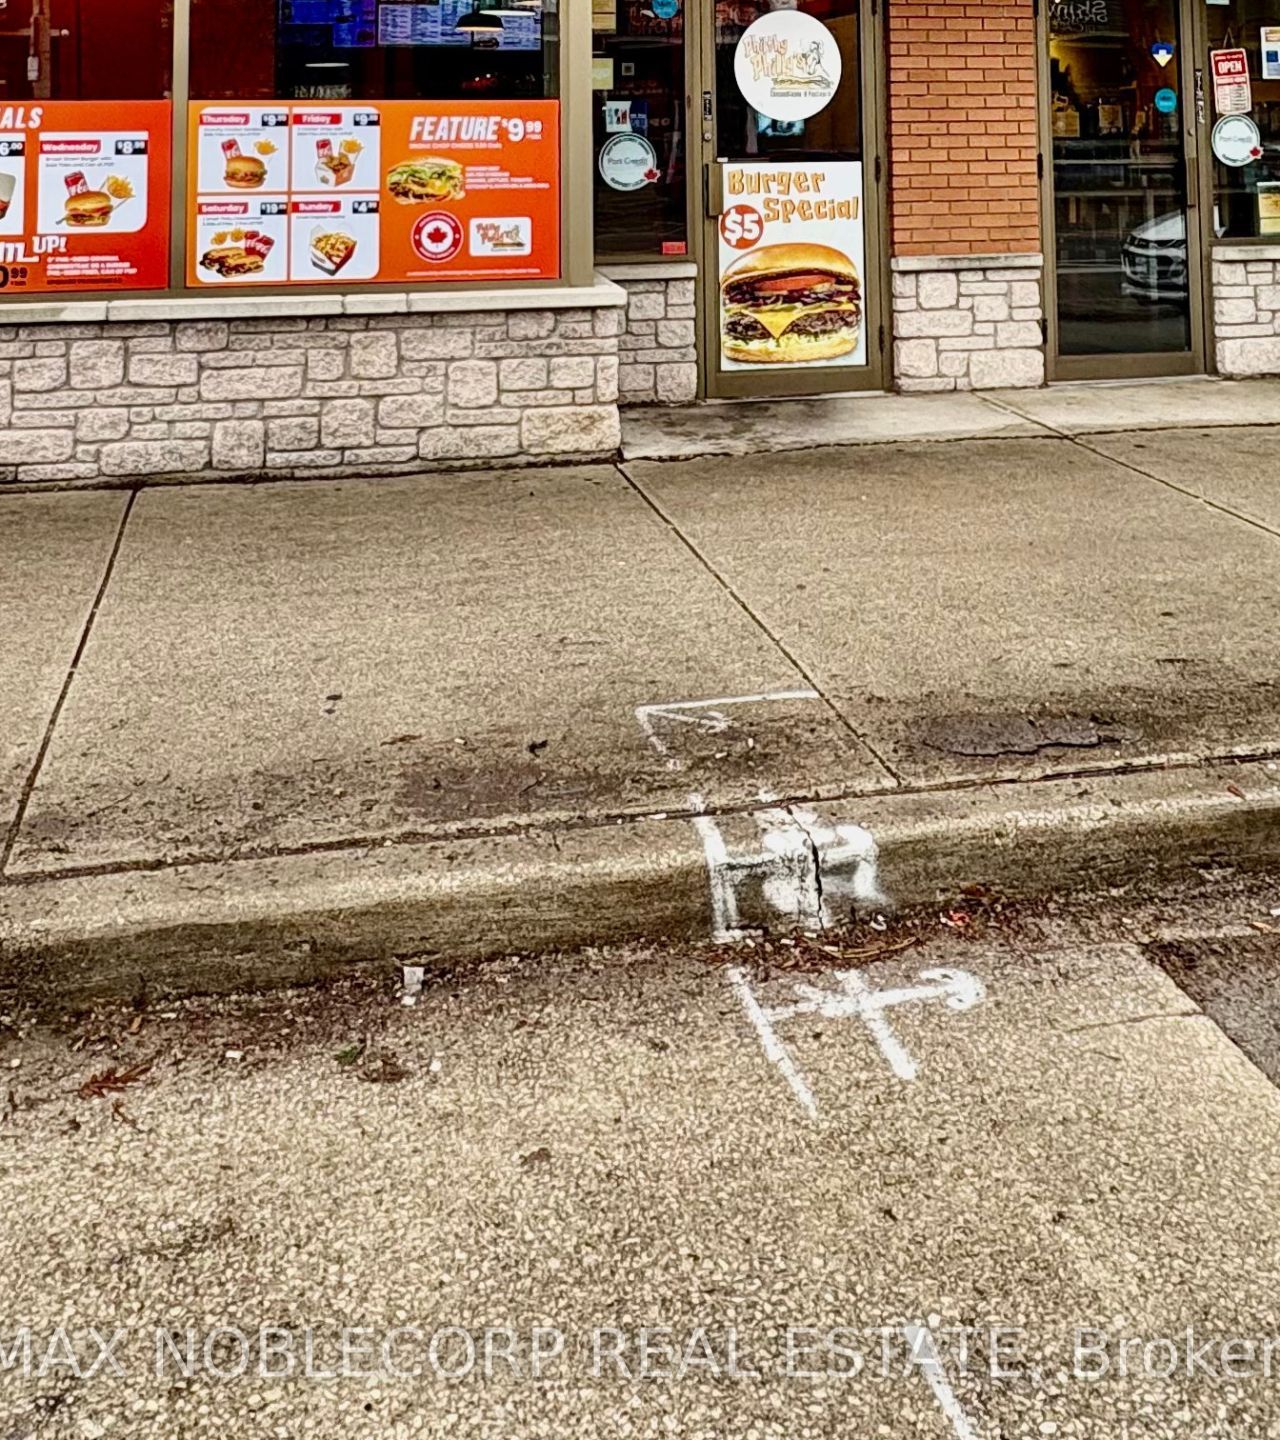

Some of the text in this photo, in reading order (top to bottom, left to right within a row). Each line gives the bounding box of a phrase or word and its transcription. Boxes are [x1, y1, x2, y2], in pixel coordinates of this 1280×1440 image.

[1218, 61, 1242, 74] OPEN
[202, 115, 247, 125] Thursday
[302, 115, 331, 125] Friday
[409, 116, 502, 141] FEATURE
[42, 143, 98, 154] Wednesday
[728, 169, 825, 195] Burger
[201, 204, 245, 214] Saturday
[299, 203, 334, 213] Sunday
[763, 196, 859, 223] Special
[724, 208, 760, 246] $5
[32, 236, 67, 254] UP!
